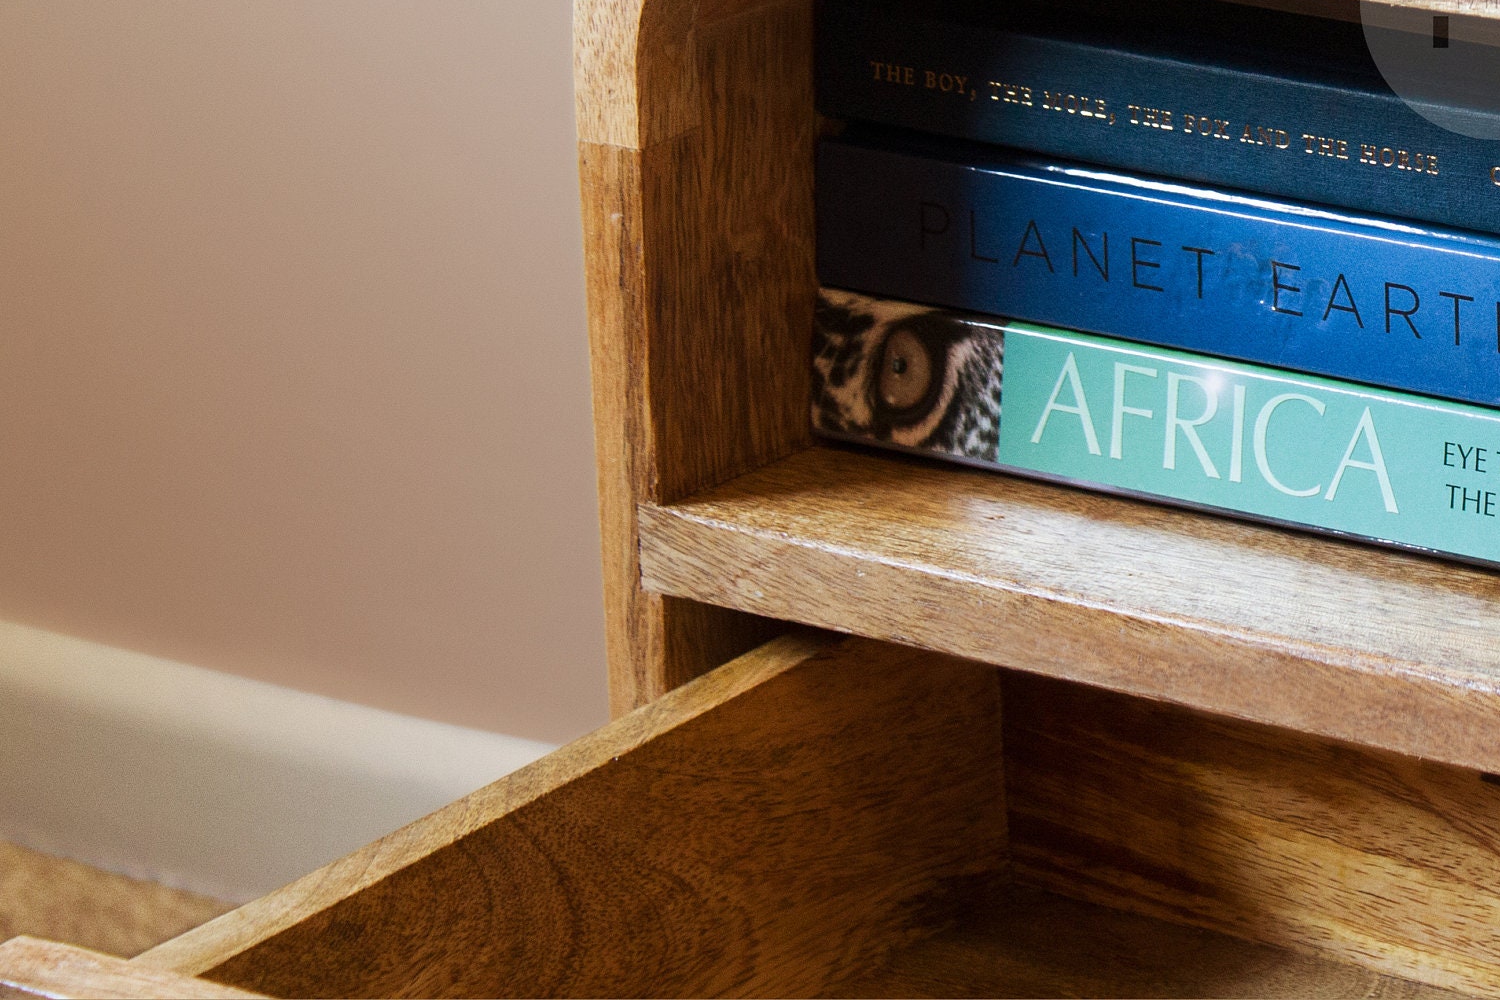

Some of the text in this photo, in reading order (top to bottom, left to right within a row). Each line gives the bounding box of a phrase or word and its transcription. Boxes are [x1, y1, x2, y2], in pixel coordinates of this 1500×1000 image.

[871, 61, 917, 88] THE
[925, 70, 978, 101] BOY,
[988, 80, 1034, 107] THE
[1042, 90, 1118, 126] MOLE,
[1129, 105, 1174, 132] THE
[1184, 113, 1230, 140] FOX
[1240, 123, 1290, 150] AND
[1302, 133, 1349, 161] THE
[1360, 143, 1440, 176] HORSE
[918, 201, 1216, 299] PLANET
[1030, 351, 1400, 514] AFRICA
[1443, 441, 1487, 473] EYE
[1446, 483, 1497, 517] THE
